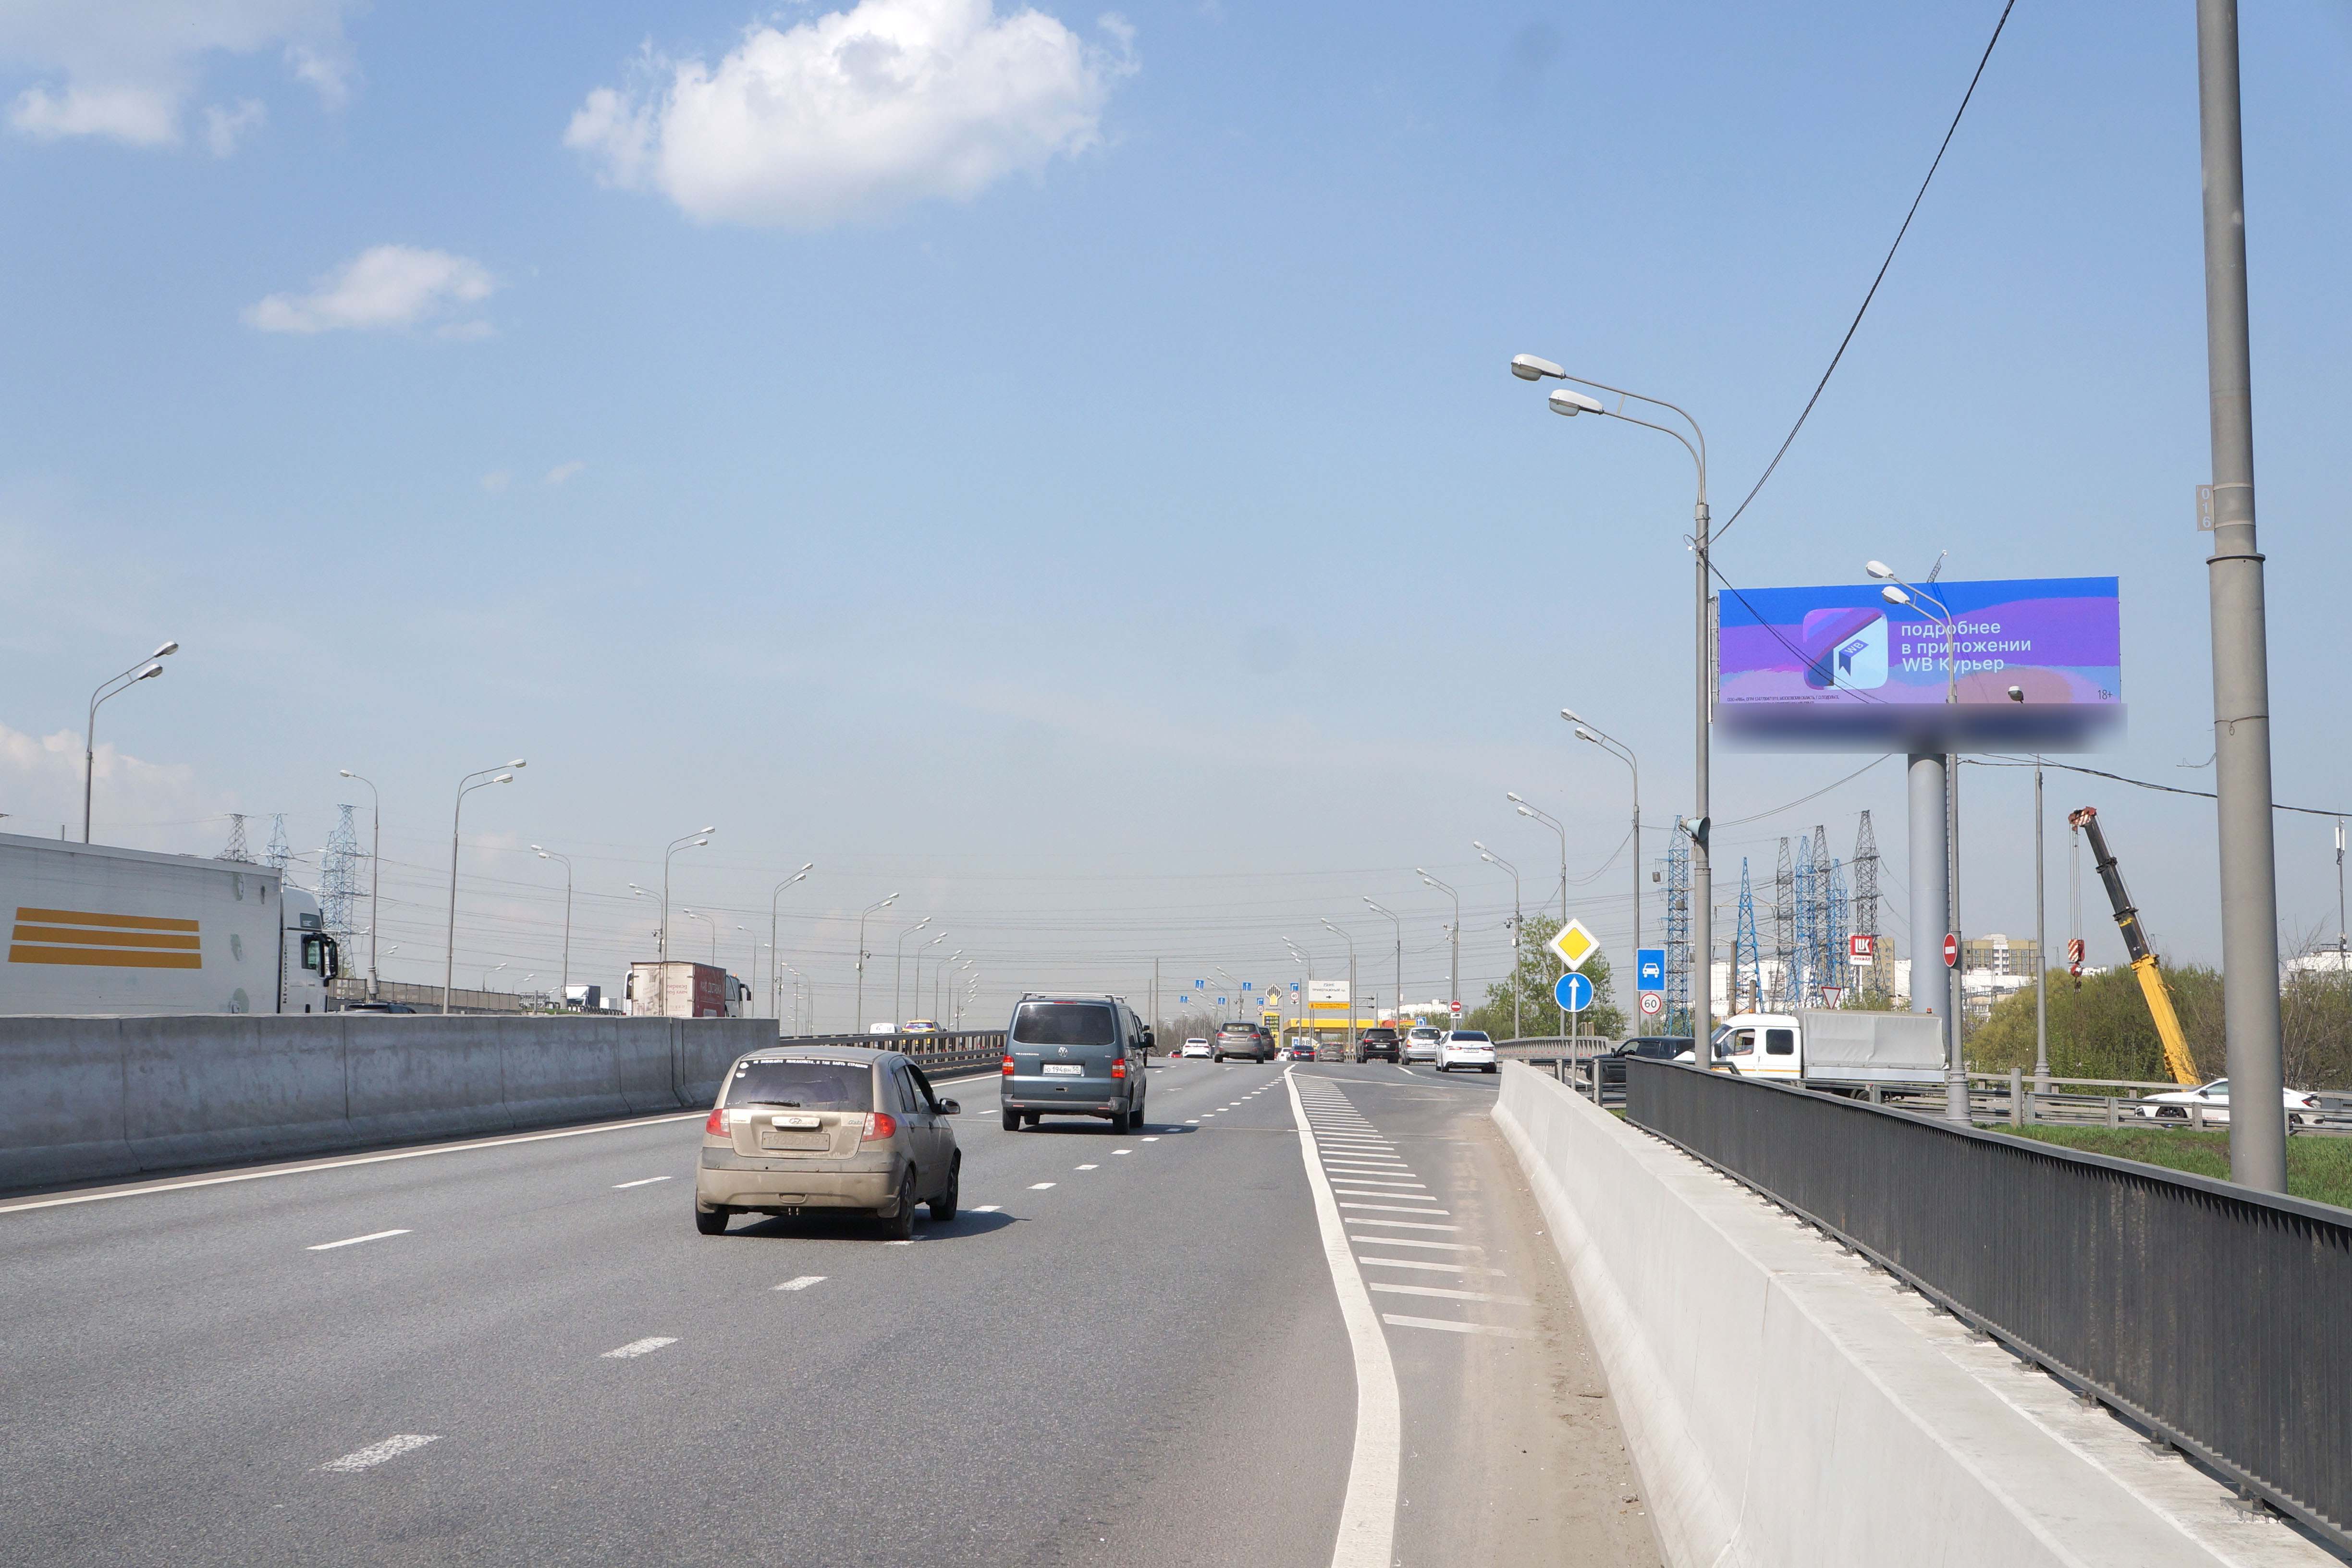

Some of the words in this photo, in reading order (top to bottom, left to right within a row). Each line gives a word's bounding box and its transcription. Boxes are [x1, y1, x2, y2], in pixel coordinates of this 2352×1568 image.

[2202, 488, 2211, 528] 016
[1901, 621, 2001, 638] подробнее
[1844, 642, 1864, 654] WB
[1901, 643, 1911, 654] в
[1917, 640, 2031, 657] приложении
[1902, 657, 1933, 672] WB
[1939, 657, 2004, 674] Курьер
[2097, 689, 2113, 700] 18+
[1644, 999, 1657, 1008] 60
